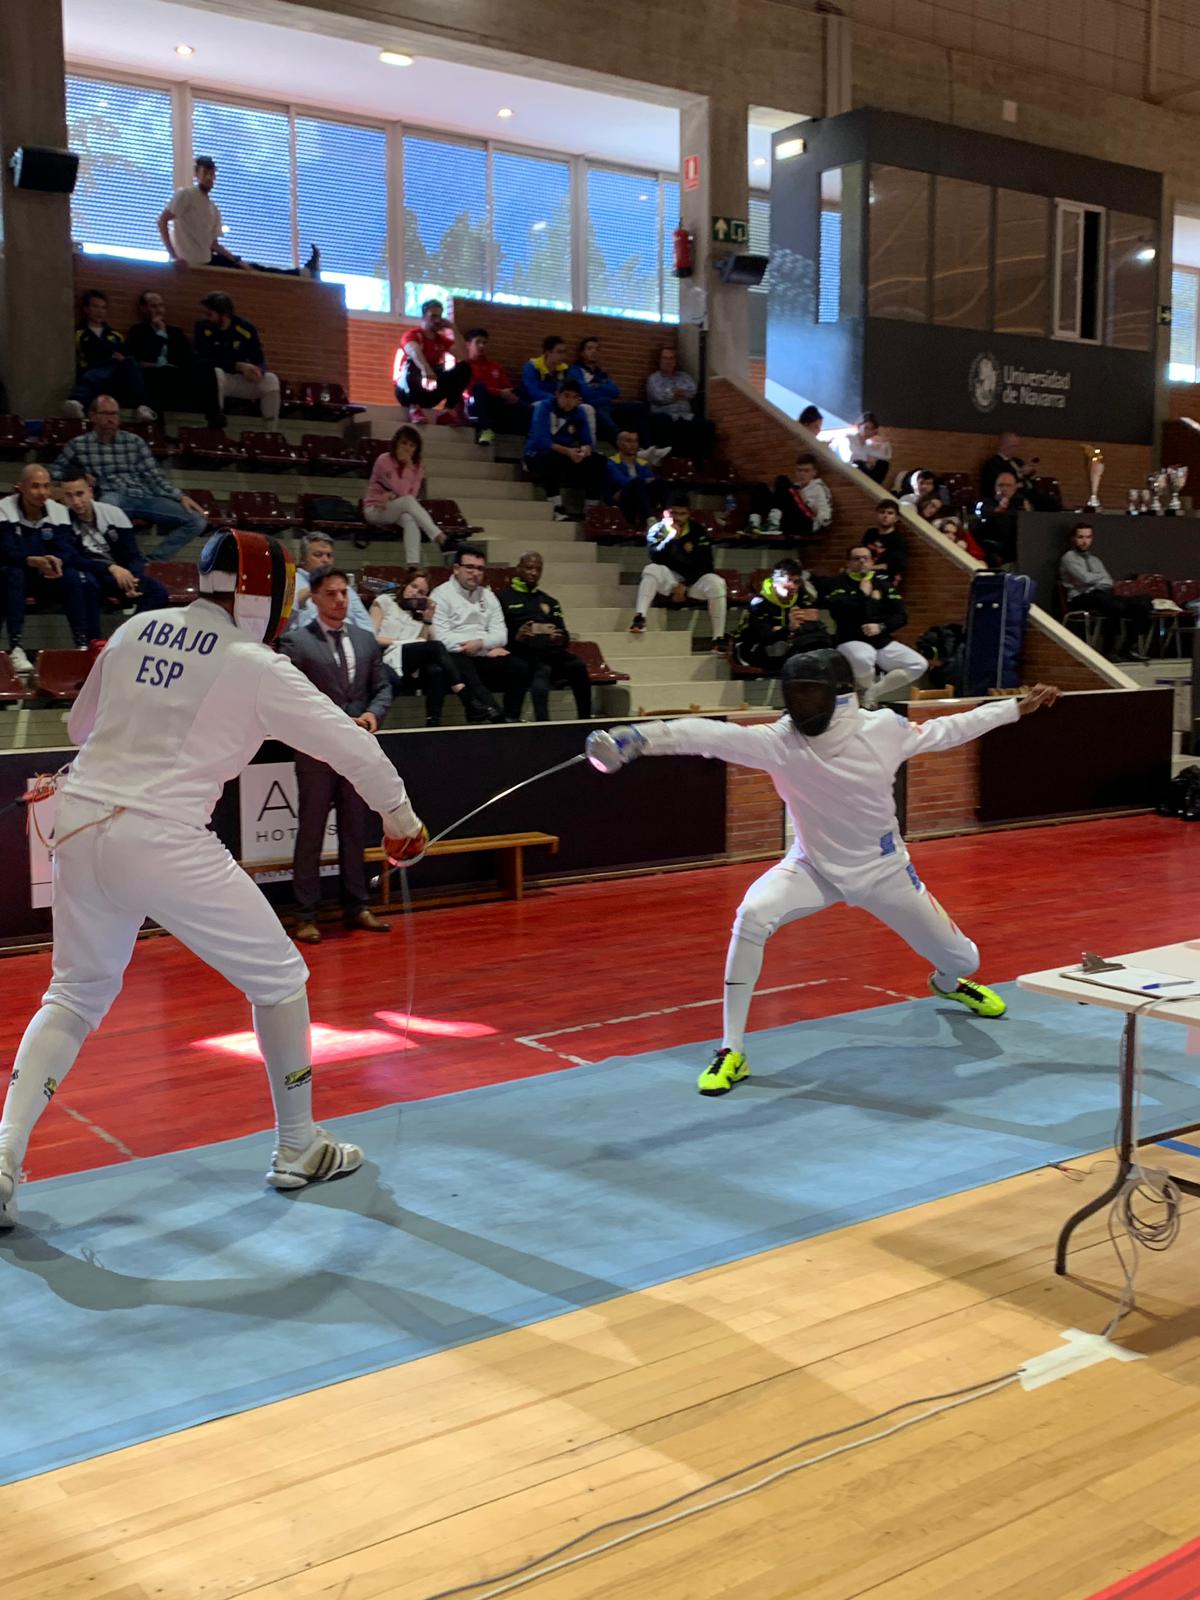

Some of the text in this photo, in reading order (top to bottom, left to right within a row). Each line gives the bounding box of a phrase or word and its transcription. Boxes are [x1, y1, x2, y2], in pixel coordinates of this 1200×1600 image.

[1003, 365, 1071, 389] Universidad
[1002, 386, 1066, 408] de Navarra
[138, 619, 219, 655] ABAJO
[135, 655, 184, 689] ESP
[256, 824, 338, 842] HOTS
